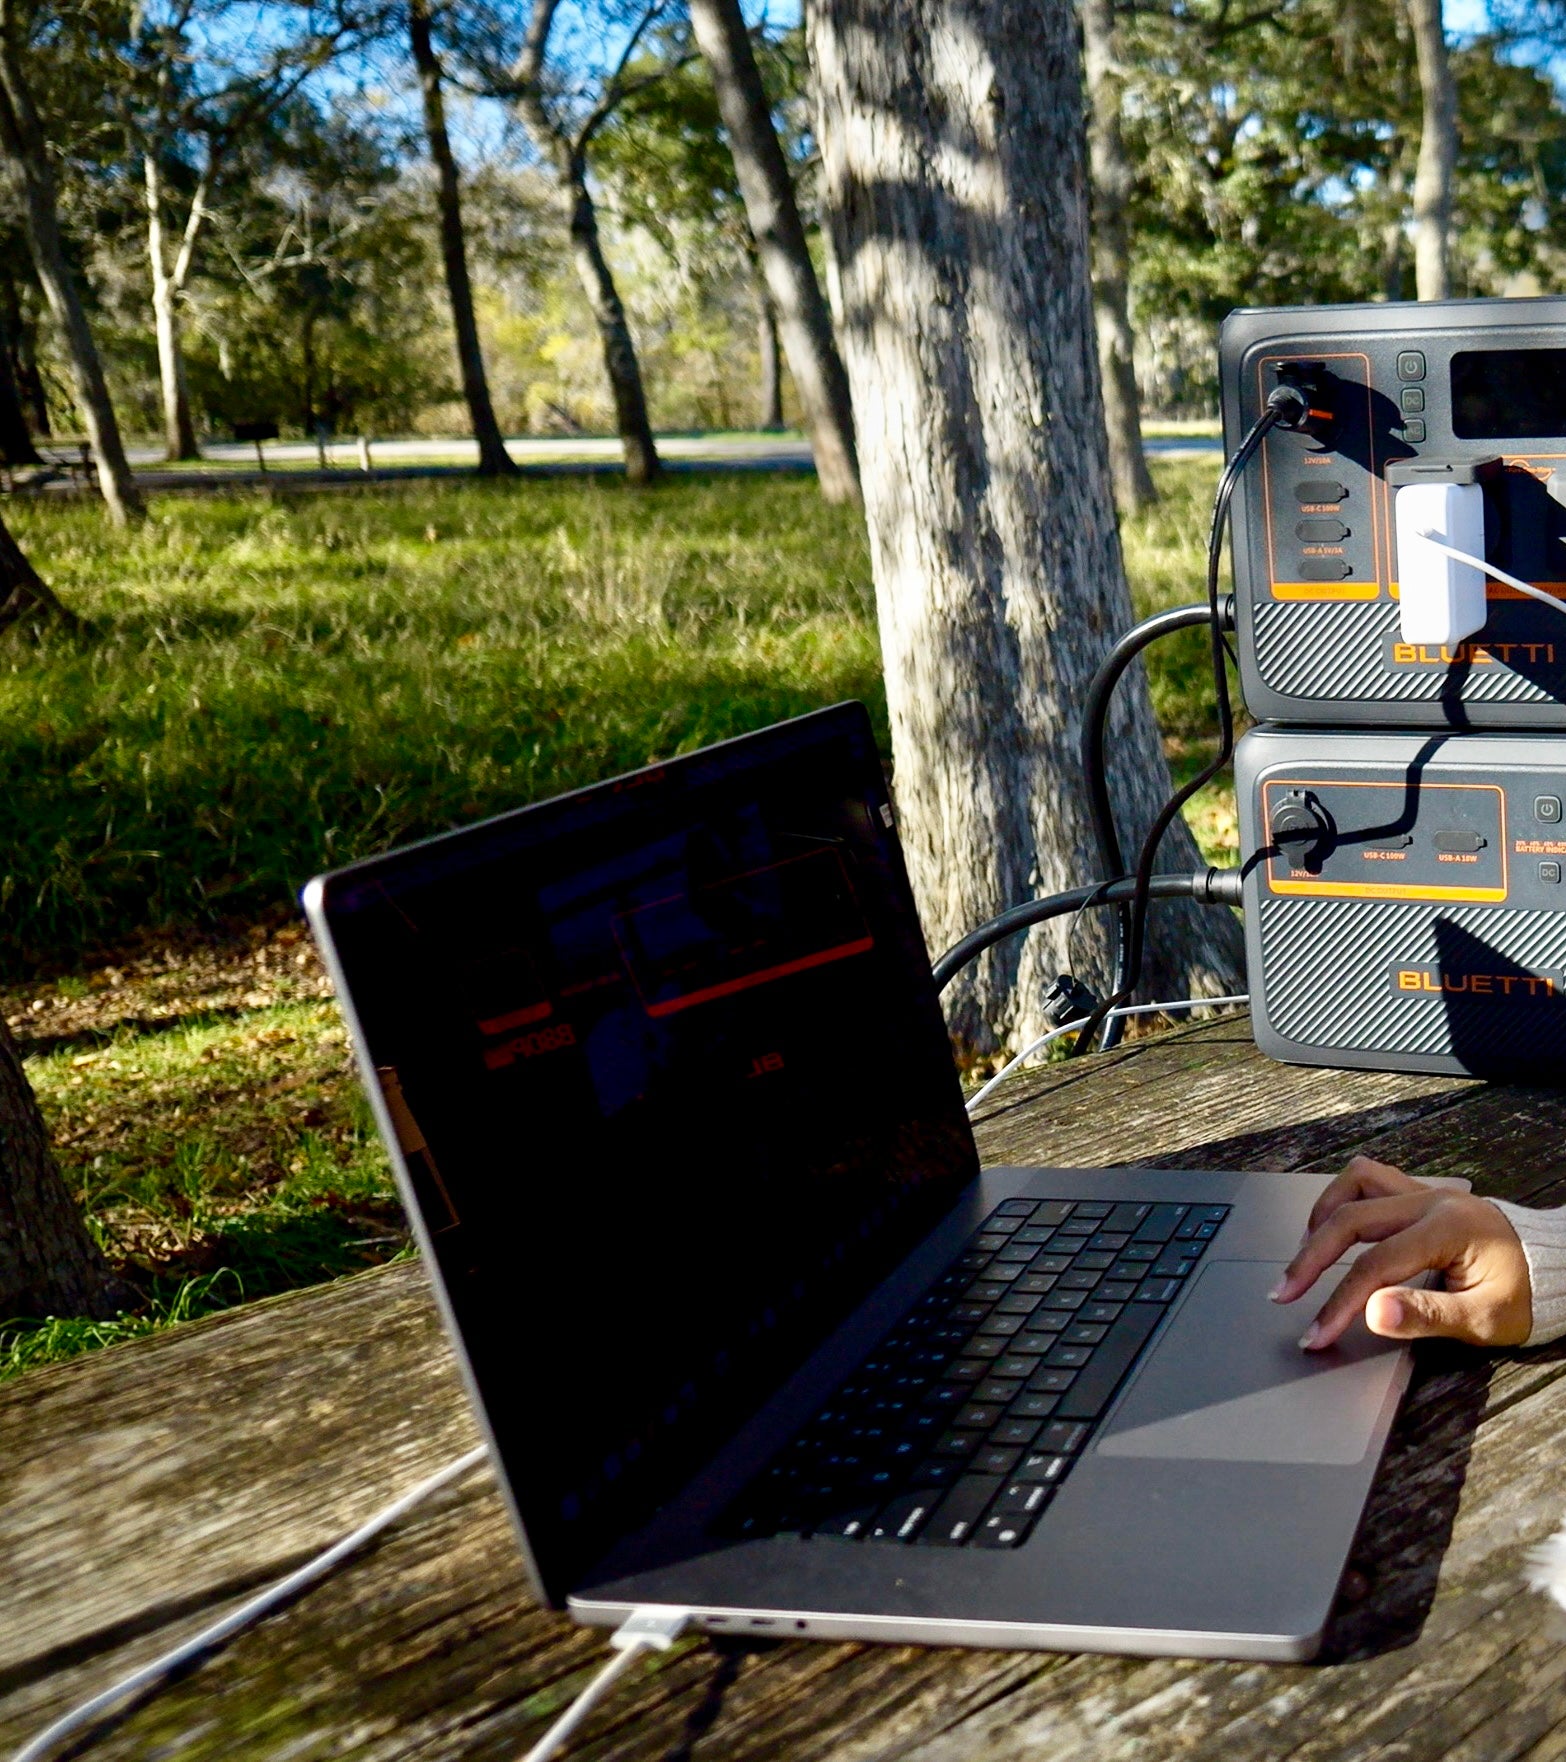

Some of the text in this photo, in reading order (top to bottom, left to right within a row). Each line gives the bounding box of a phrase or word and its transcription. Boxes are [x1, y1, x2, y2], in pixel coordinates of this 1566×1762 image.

[1405, 396, 1420, 406] DC
[1393, 642, 1556, 665] BLUETTI
[1363, 852, 1385, 860] USB-C
[1439, 854, 1461, 862] USB-A
[1541, 868, 1556, 877] DC
[1397, 970, 1554, 998] BLUETTI
